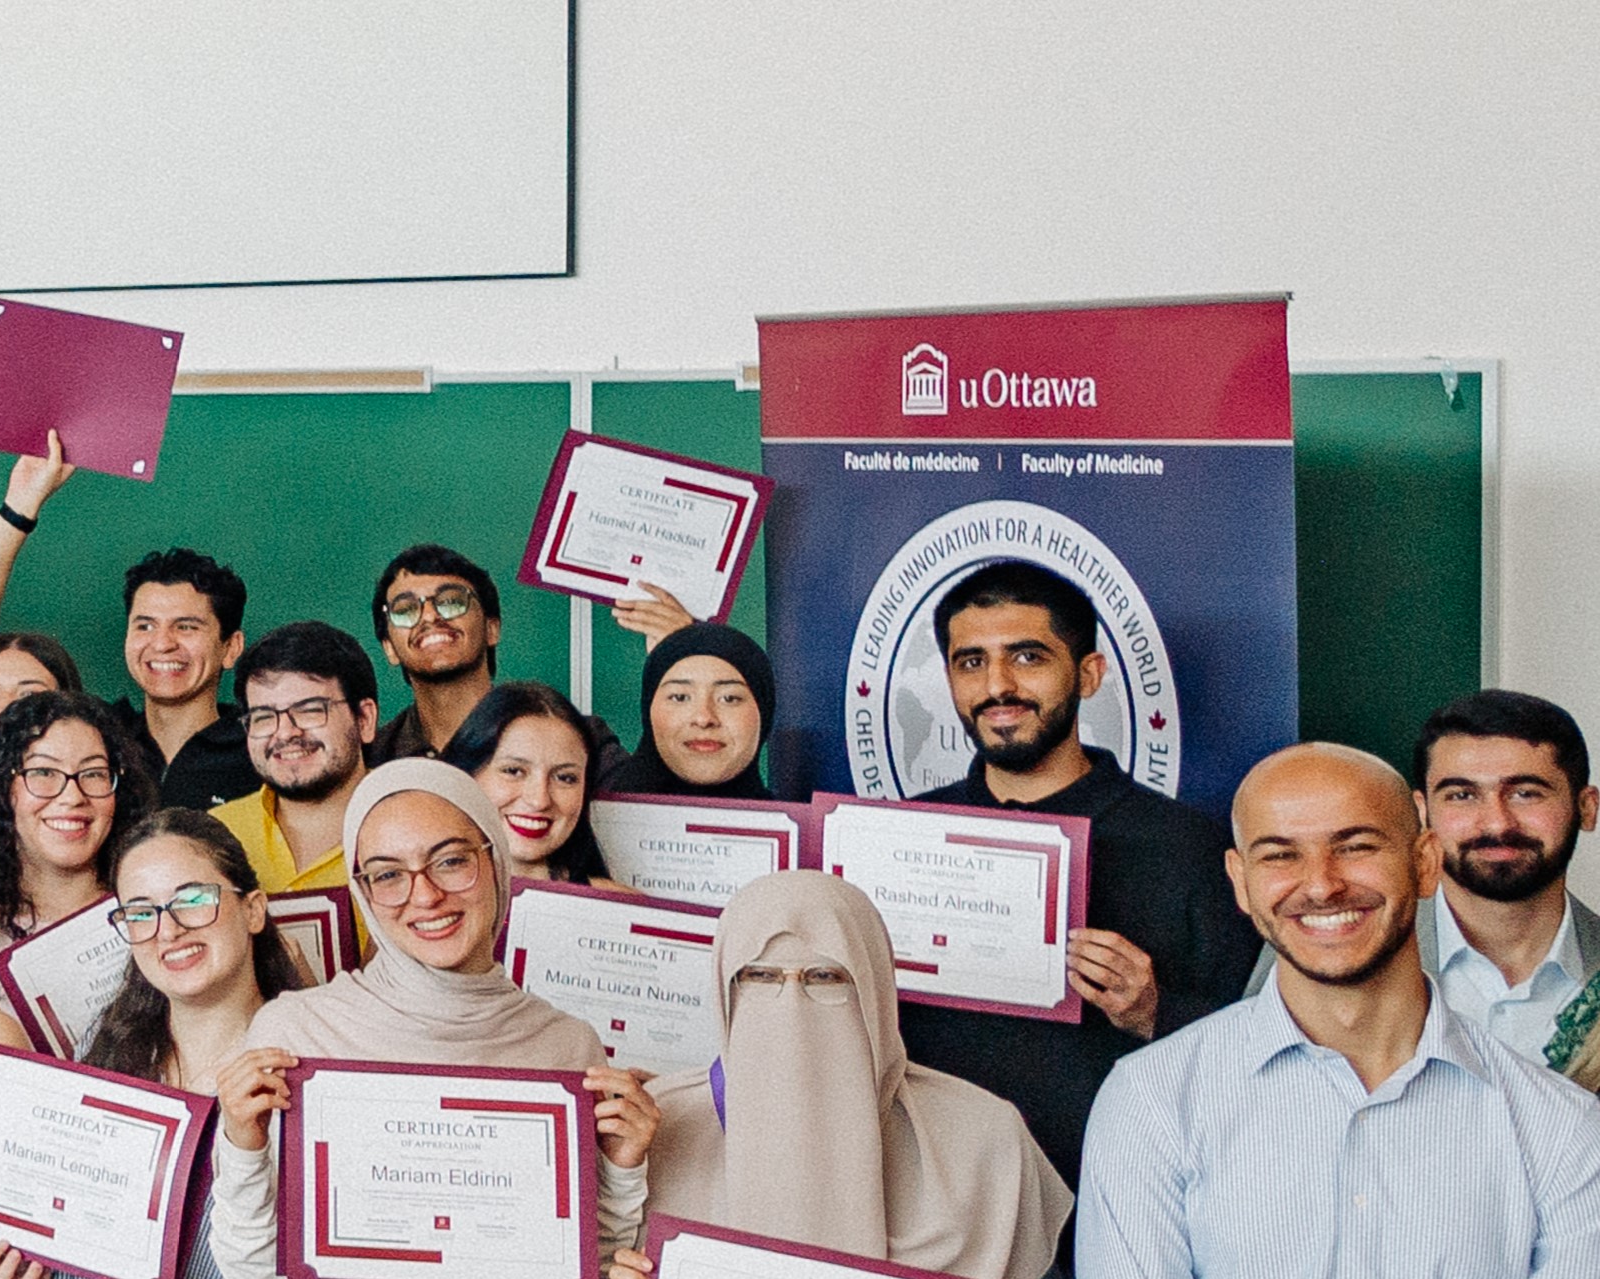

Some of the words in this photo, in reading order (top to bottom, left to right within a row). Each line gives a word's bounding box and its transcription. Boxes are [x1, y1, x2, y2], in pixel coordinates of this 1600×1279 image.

[959, 368, 1097, 408] uOttawa
[844, 451, 891, 471] Faculté
[892, 452, 911, 471] de
[912, 451, 980, 472] médecine
[1022, 453, 1074, 477] Faculty
[1076, 454, 1095, 474] of
[1096, 454, 1164, 476] Medicine
[619, 484, 696, 512] CERTIFICATE
[588, 510, 636, 531] Hamed
[654, 526, 707, 549] Haddad
[861, 583, 905, 671] LEADING
[901, 521, 991, 593] INNOVATION
[995, 518, 1028, 543] FOR
[1032, 525, 1043, 546] A
[1047, 529, 1131, 619] HEALTHIER
[1122, 611, 1162, 697] WORLD
[855, 709, 876, 761] CHEF
[1146, 741, 1169, 787] NTÉ
[862, 765, 883, 795] DE
[639, 839, 732, 858] CERTIFICATE
[893, 850, 996, 873] CERTIFICATE
[631, 874, 696, 893] Fareeha
[701, 877, 739, 895] Azizi
[874, 886, 939, 908] Rashed
[944, 893, 1011, 916] Alredha
[77, 936, 122, 965] CERTIF
[578, 937, 678, 963] CERTIFICATE
[545, 969, 592, 988] Maria
[596, 977, 642, 998] Luiza
[646, 985, 702, 1008] Nunes
[32, 1105, 119, 1139] CERTIFICATE
[384, 1121, 499, 1139] CERTIFICATE
[412, 1140, 482, 1151] APPRECIATION
[3, 1139, 57, 1169] Mariam
[60, 1153, 131, 1189] Lemghari
[372, 1165, 442, 1185] Mariam
[449, 1169, 513, 1188] Eldirini
